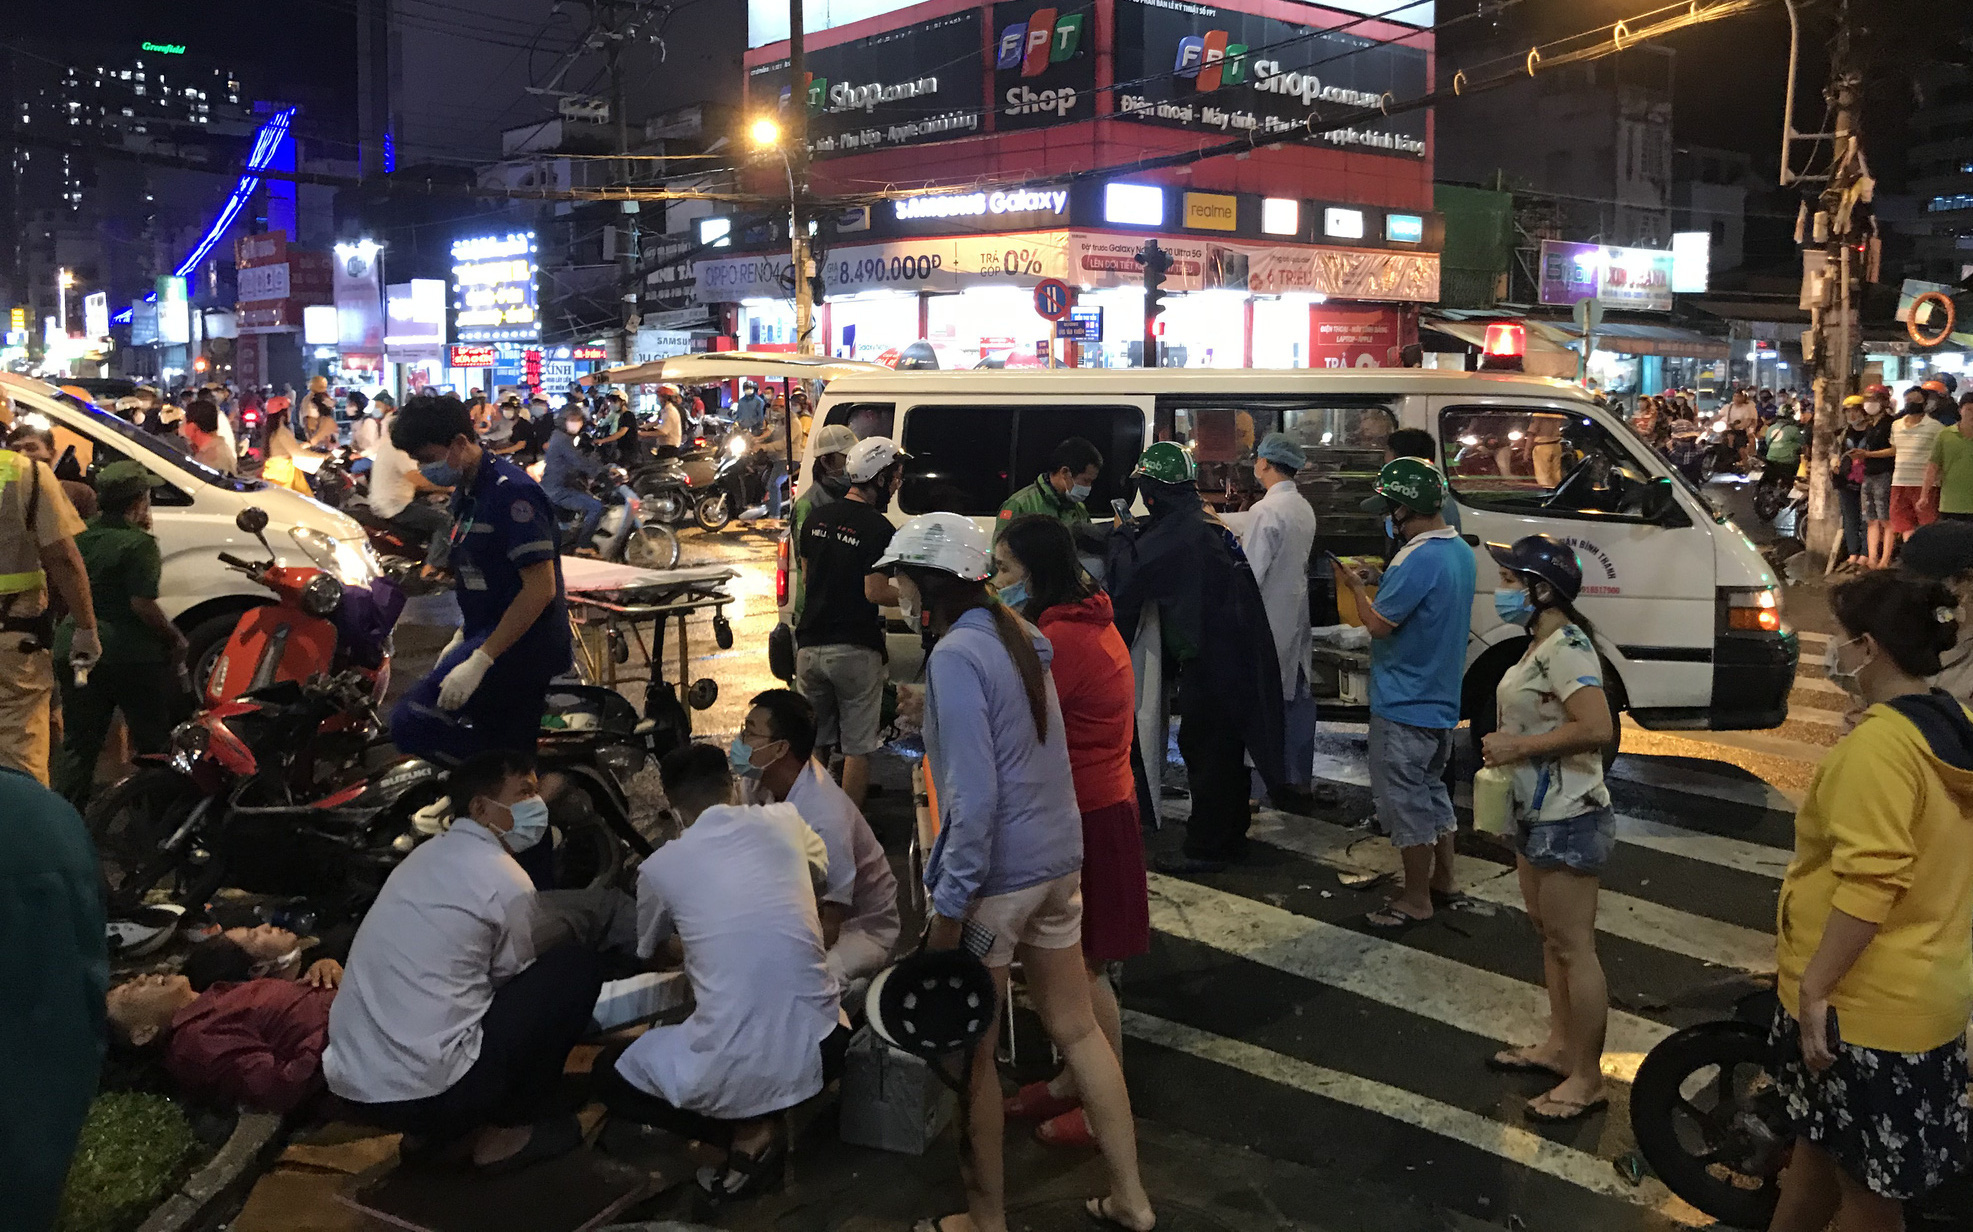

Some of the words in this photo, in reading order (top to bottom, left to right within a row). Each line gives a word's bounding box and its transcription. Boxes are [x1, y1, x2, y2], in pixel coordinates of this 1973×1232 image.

[1000, 24, 1076, 60] FPT
[1181, 44, 1246, 76] FPT
[1253, 60, 1382, 109] Shop.com.vn
[830, 78, 938, 113] Shop.com.vn
[1004, 85, 1077, 117] Shop
[1156, 99, 1193, 125] thoại
[1201, 106, 1230, 131] Máy
[1230, 110, 1258, 130] tính
[1359, 130, 1394, 150] chính
[1394, 133, 1426, 157] hãng
[896, 193, 986, 219] SAMSUNG
[989, 189, 1067, 214] Galaxy
[1191, 204, 1232, 218] realme
[980, 250, 999, 264] TRẢ
[1108, 244, 1135, 255] Galaxy
[1173, 249, 1190, 257] Ultra
[1191, 249, 1202, 257] 5G
[980, 265, 1000, 278] GÓP
[1003, 249, 1042, 275] 0%
[705, 264, 738, 287] OPPO
[740, 261, 781, 284] RENO4
[656, 337, 692, 346] SAMSU
[1336, 335, 1355, 343] LAPTOP
[1390, 480, 1419, 500] Grab
[1581, 585, 1620, 595] 918517900
[379, 767, 432, 788] SUZUKI
